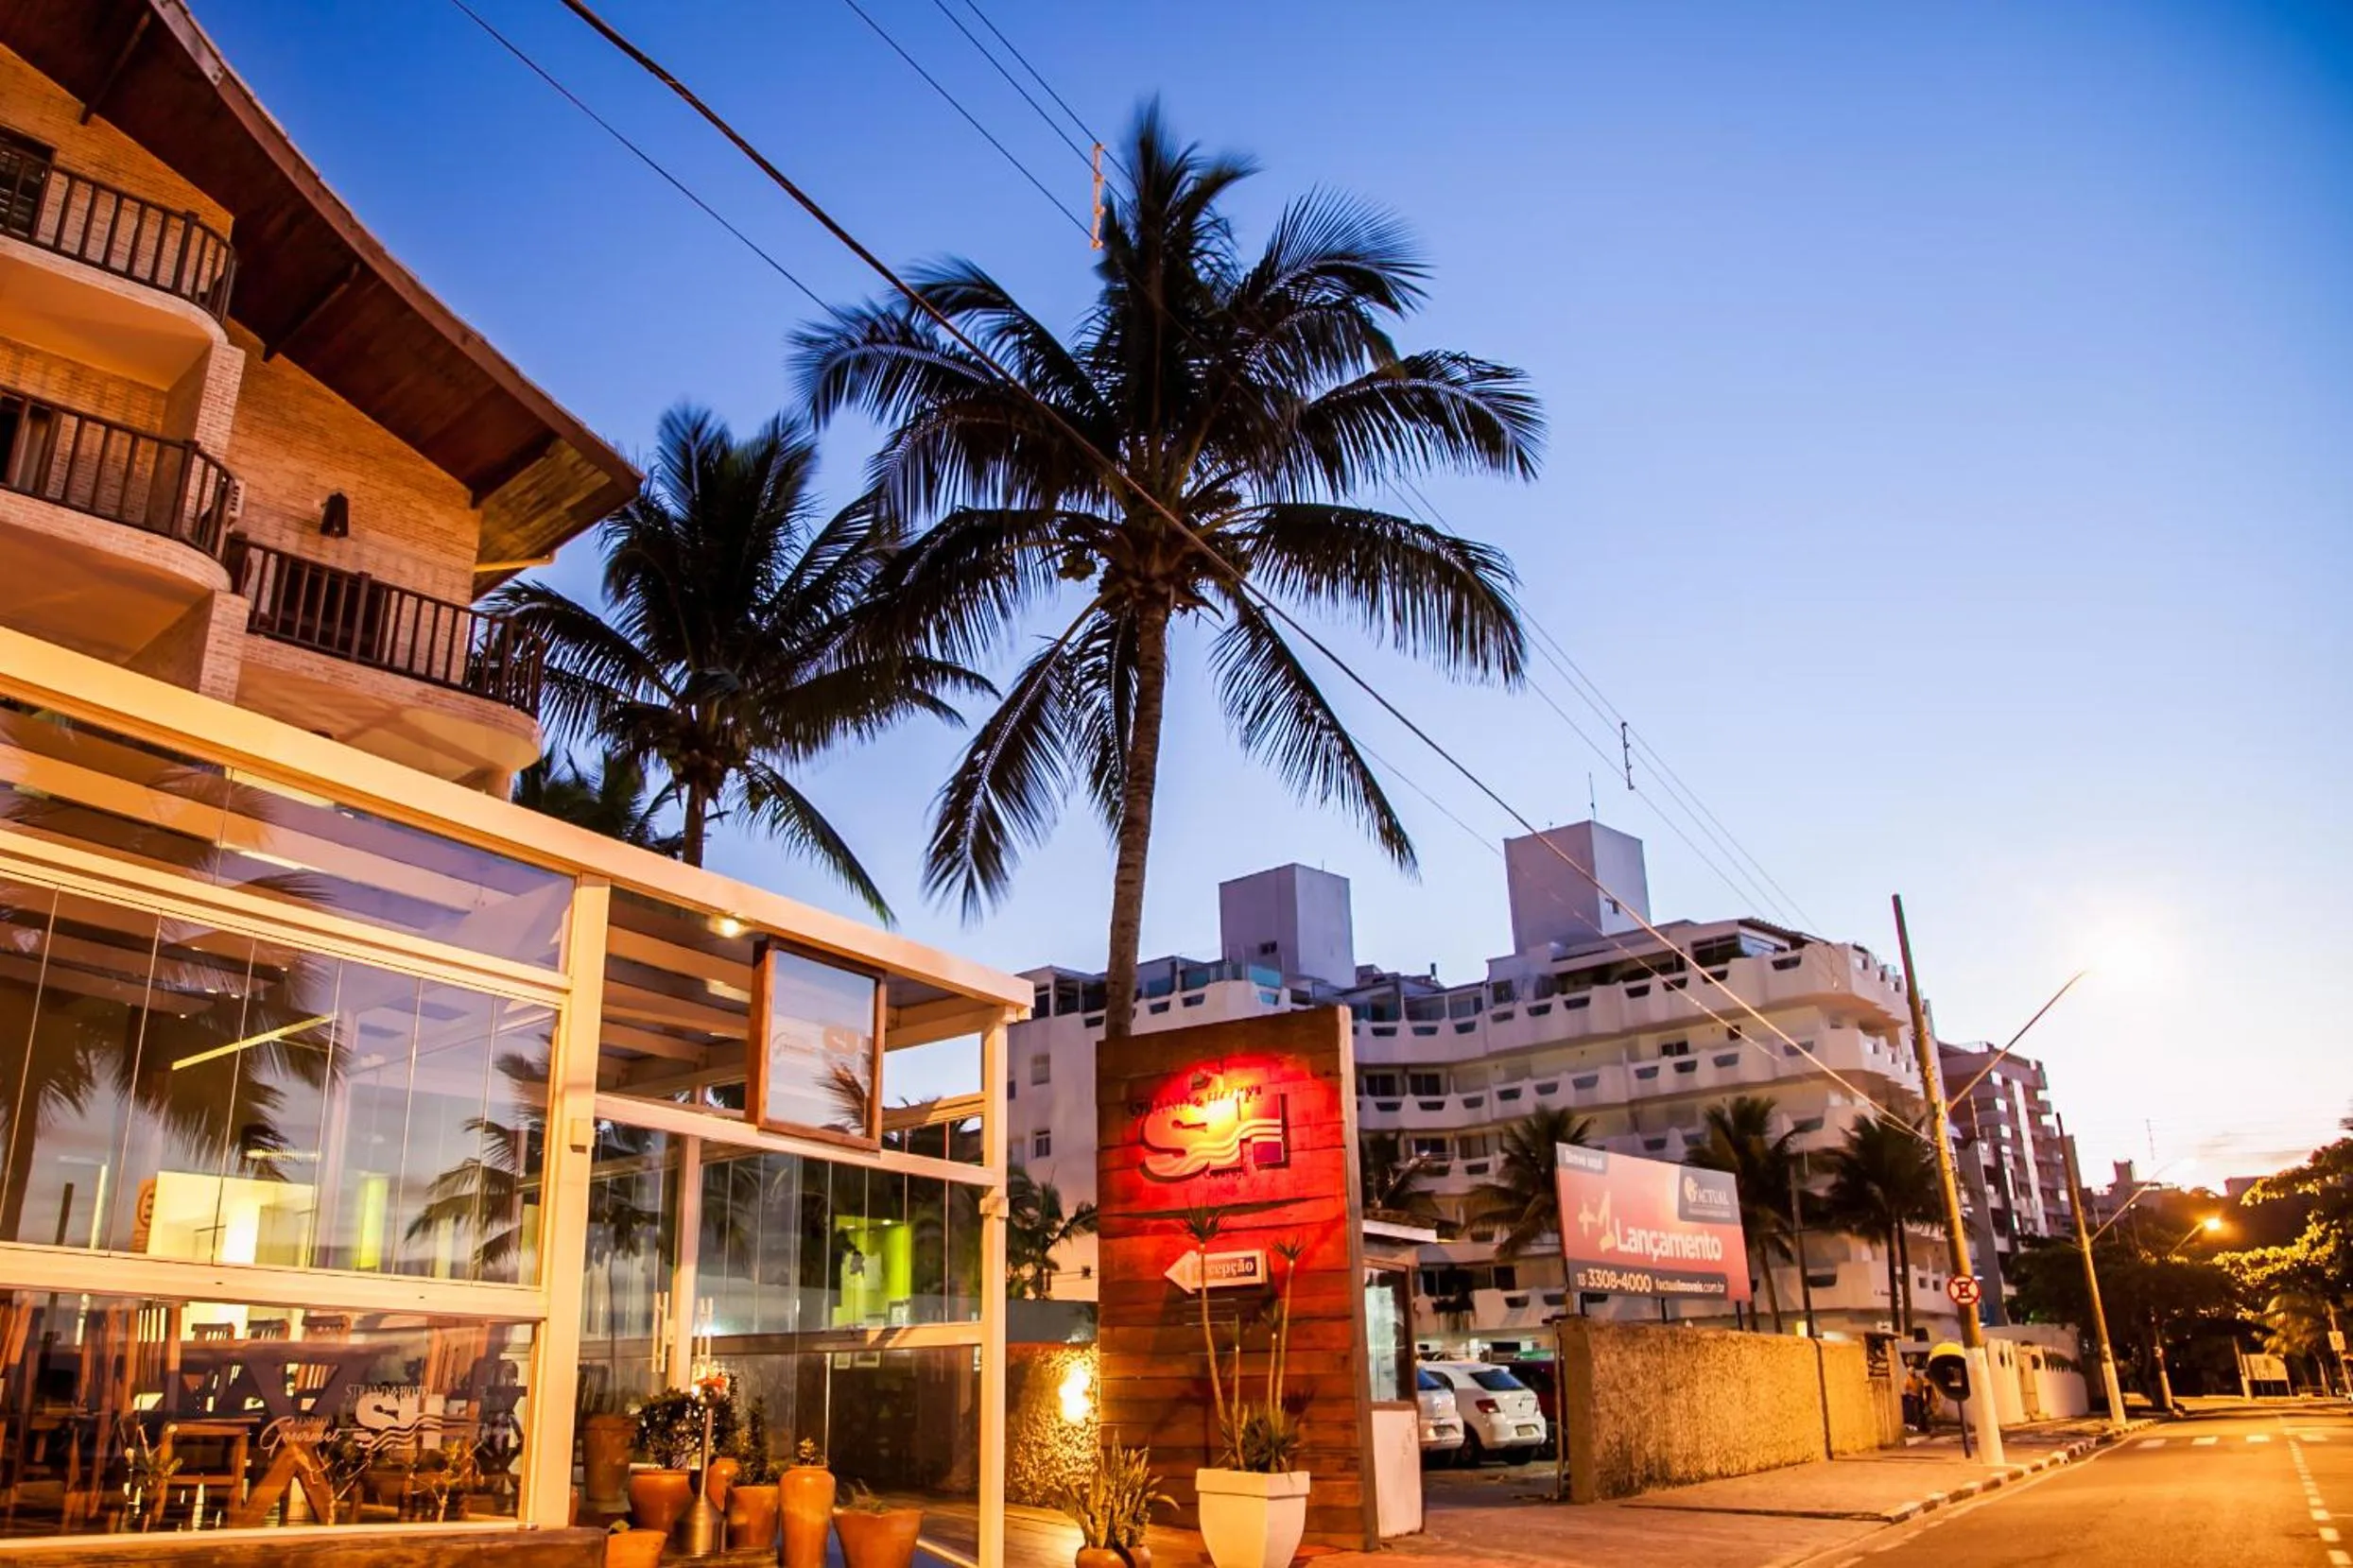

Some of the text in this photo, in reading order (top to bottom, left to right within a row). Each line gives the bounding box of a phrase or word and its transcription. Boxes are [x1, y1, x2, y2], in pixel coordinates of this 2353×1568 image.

[1616, 1218, 1722, 1263] Lançamento
[1195, 1257, 1254, 1278] cepção
[1586, 1267, 1652, 1293] 3308-4000
